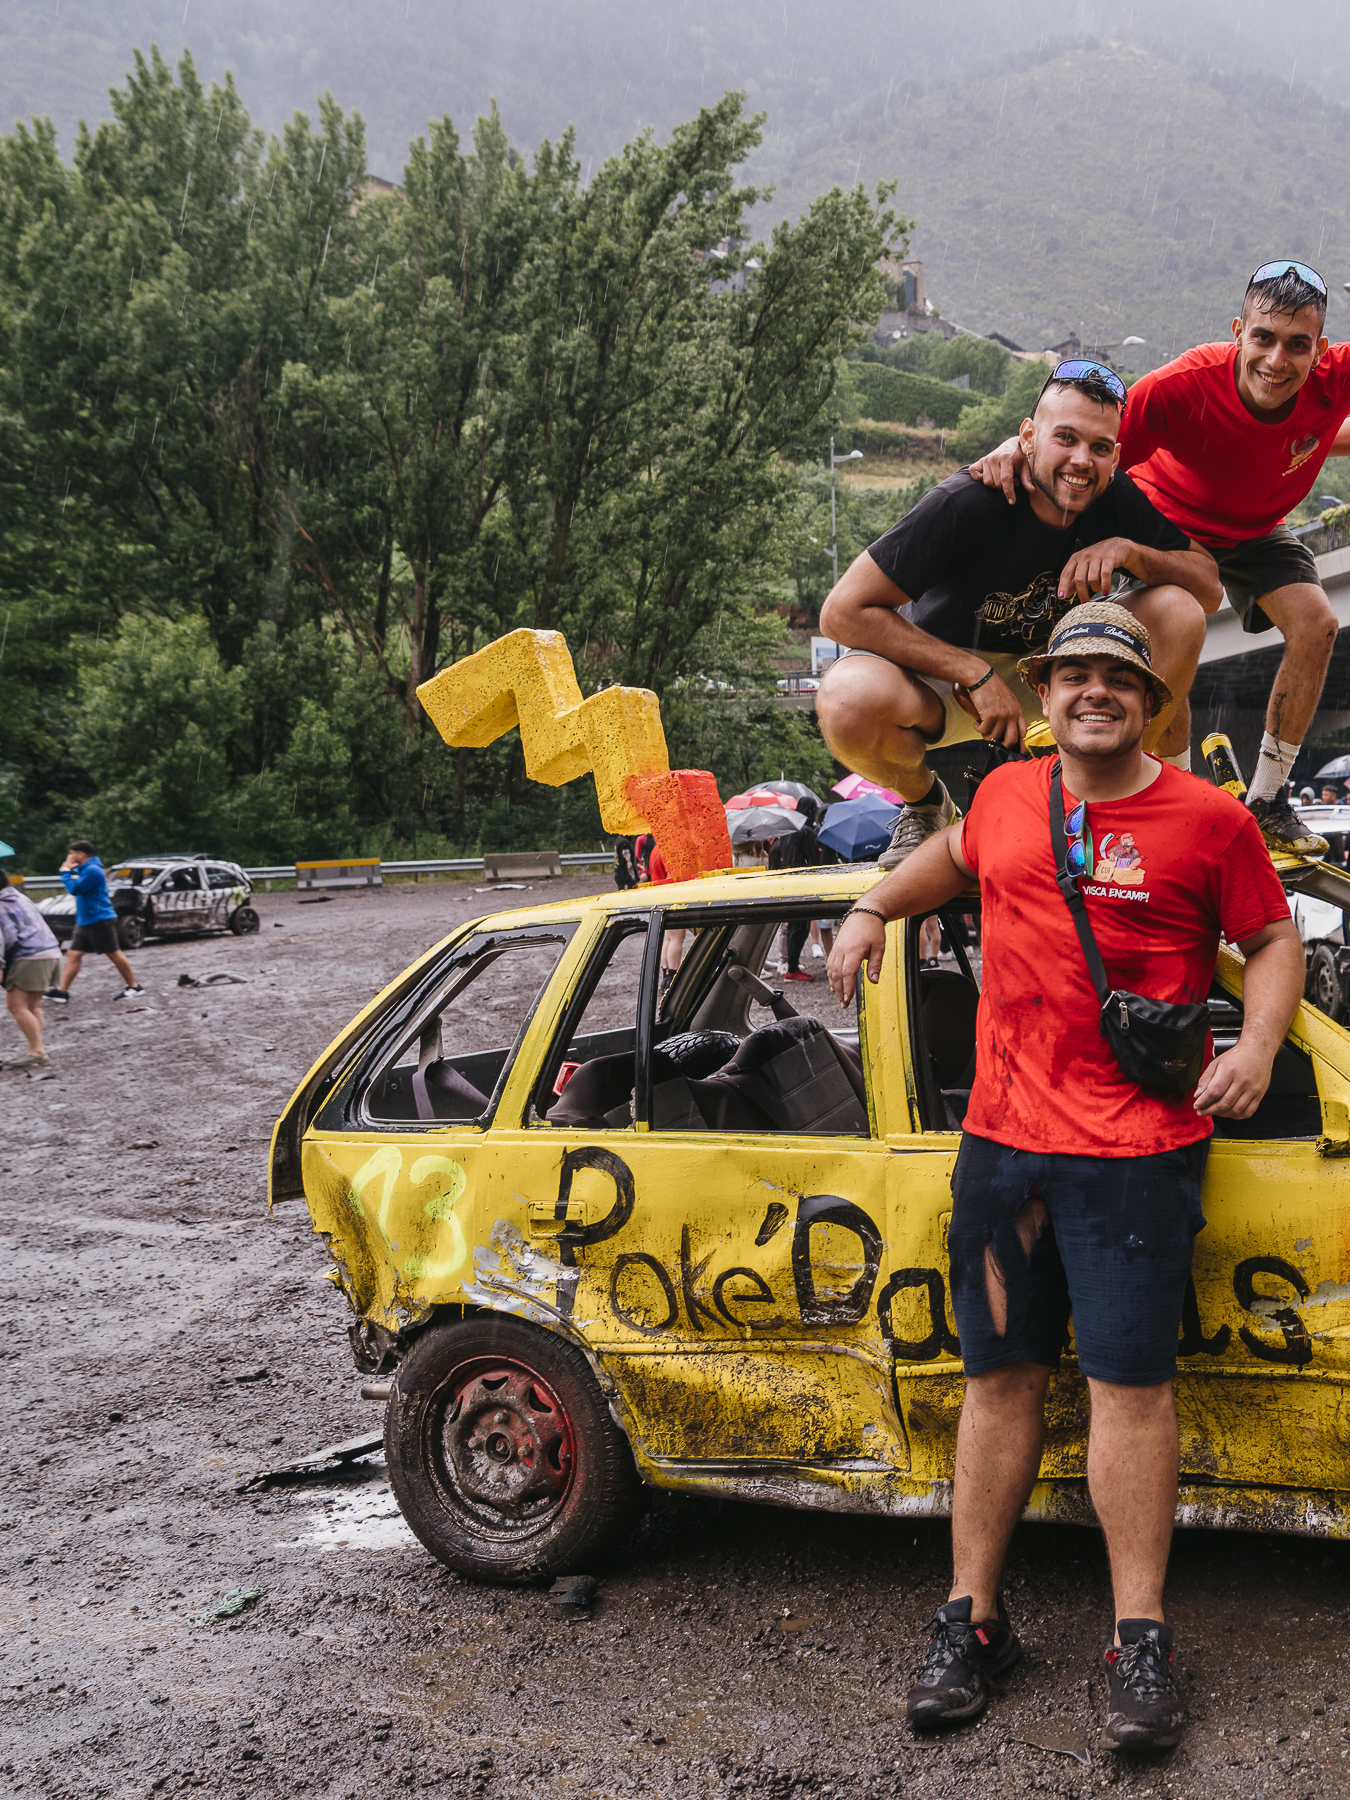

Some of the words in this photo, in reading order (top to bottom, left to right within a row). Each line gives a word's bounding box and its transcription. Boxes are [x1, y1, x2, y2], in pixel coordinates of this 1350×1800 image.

[1082, 885, 1107, 898] VISCA
[1107, 887, 1150, 904] ENCAMP!
[349, 1146, 469, 1279] 13
